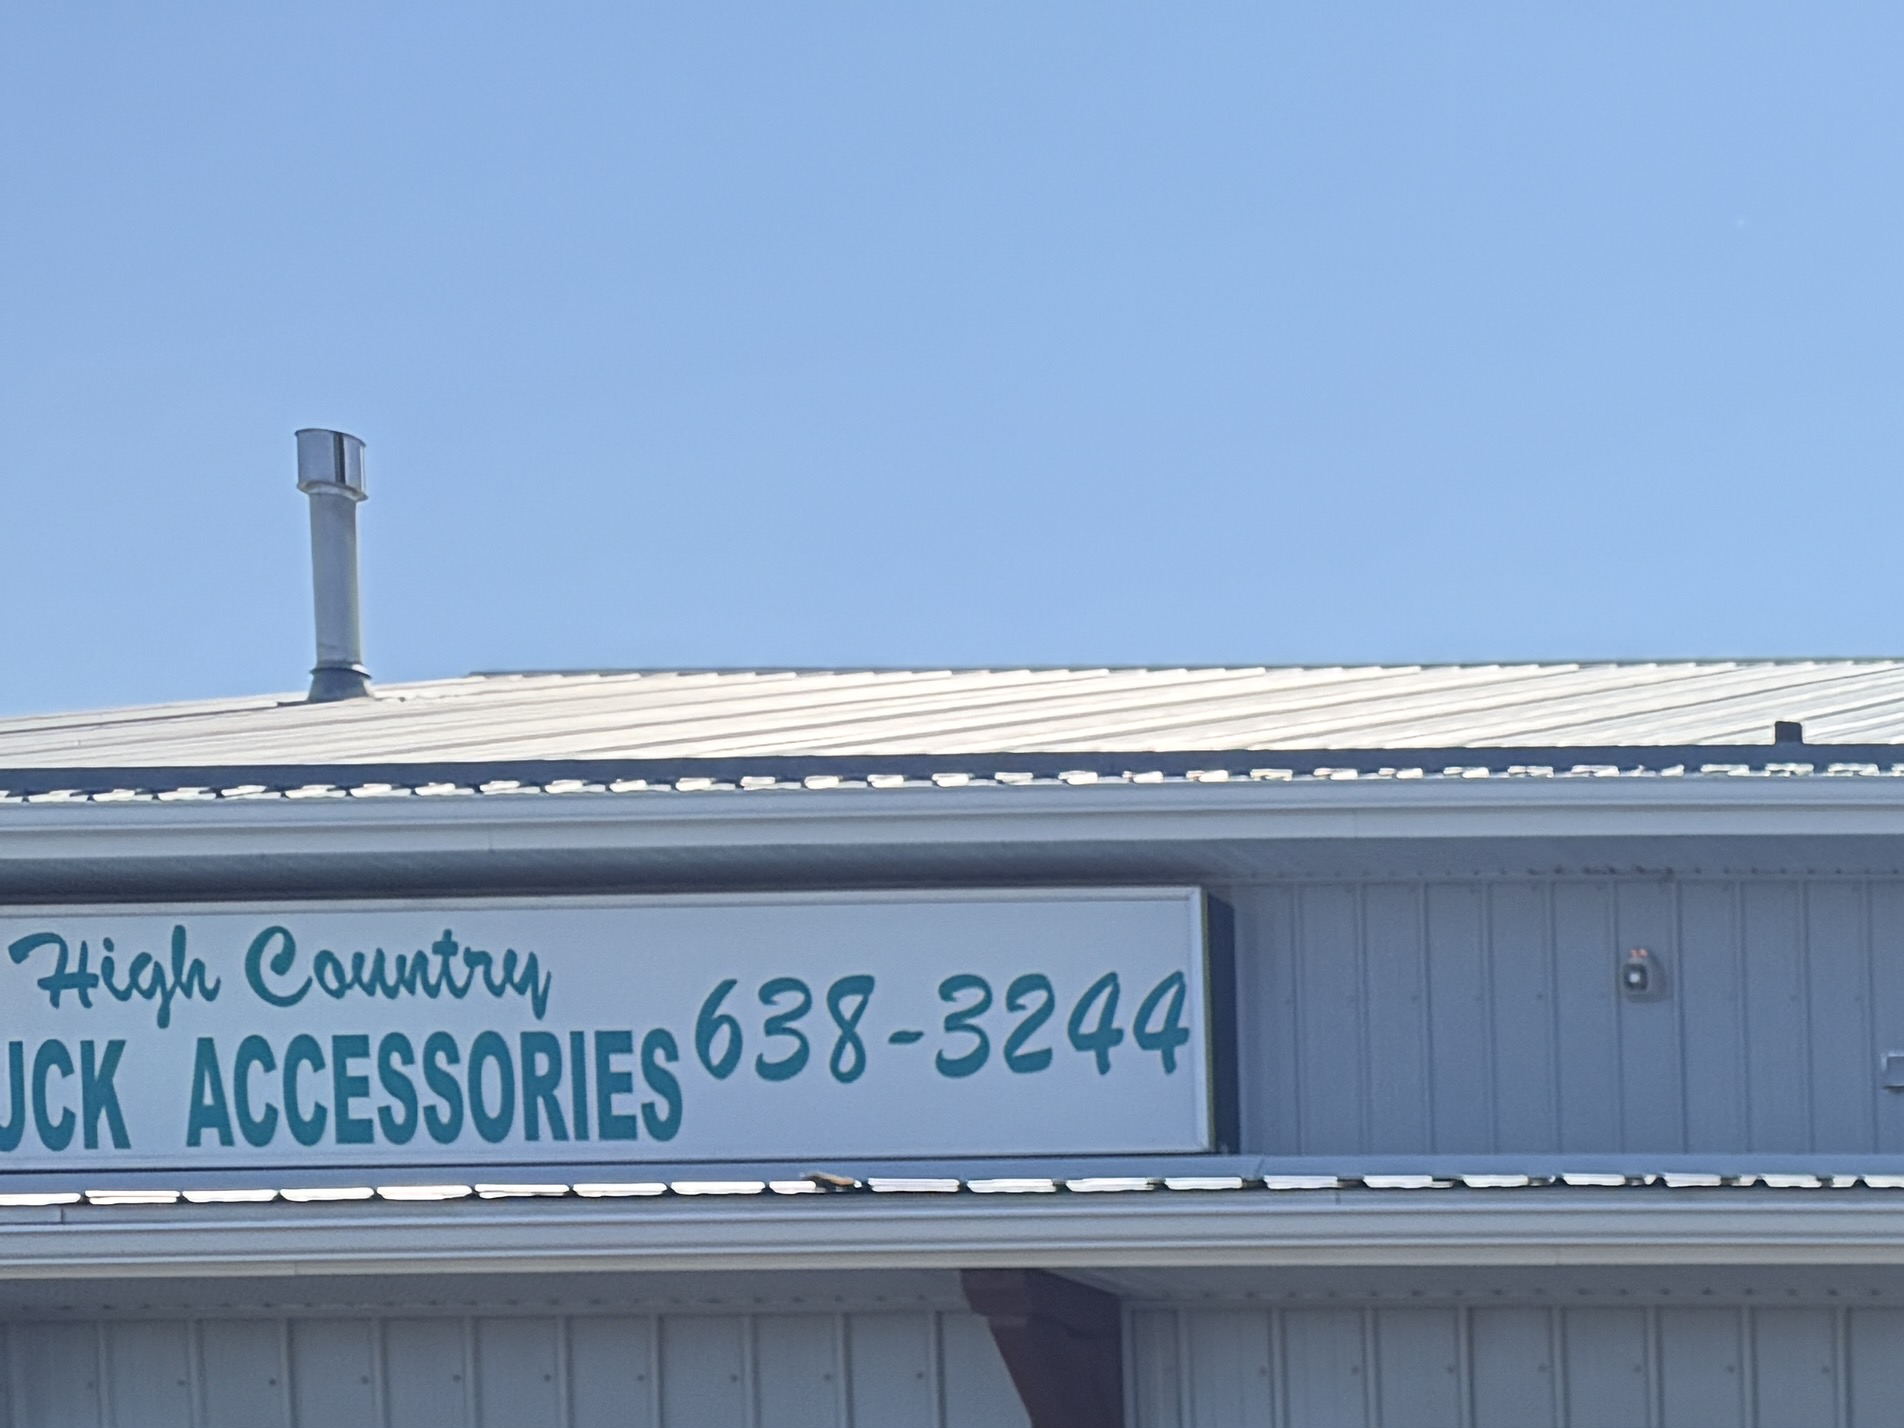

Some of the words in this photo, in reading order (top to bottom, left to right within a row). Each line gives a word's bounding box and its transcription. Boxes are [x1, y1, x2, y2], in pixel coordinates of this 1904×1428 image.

[7, 924, 222, 1030] High
[244, 925, 552, 1021] Country
[695, 970, 1191, 1084] 638-3244
[186, 1028, 683, 1148] ACCESSORIES
